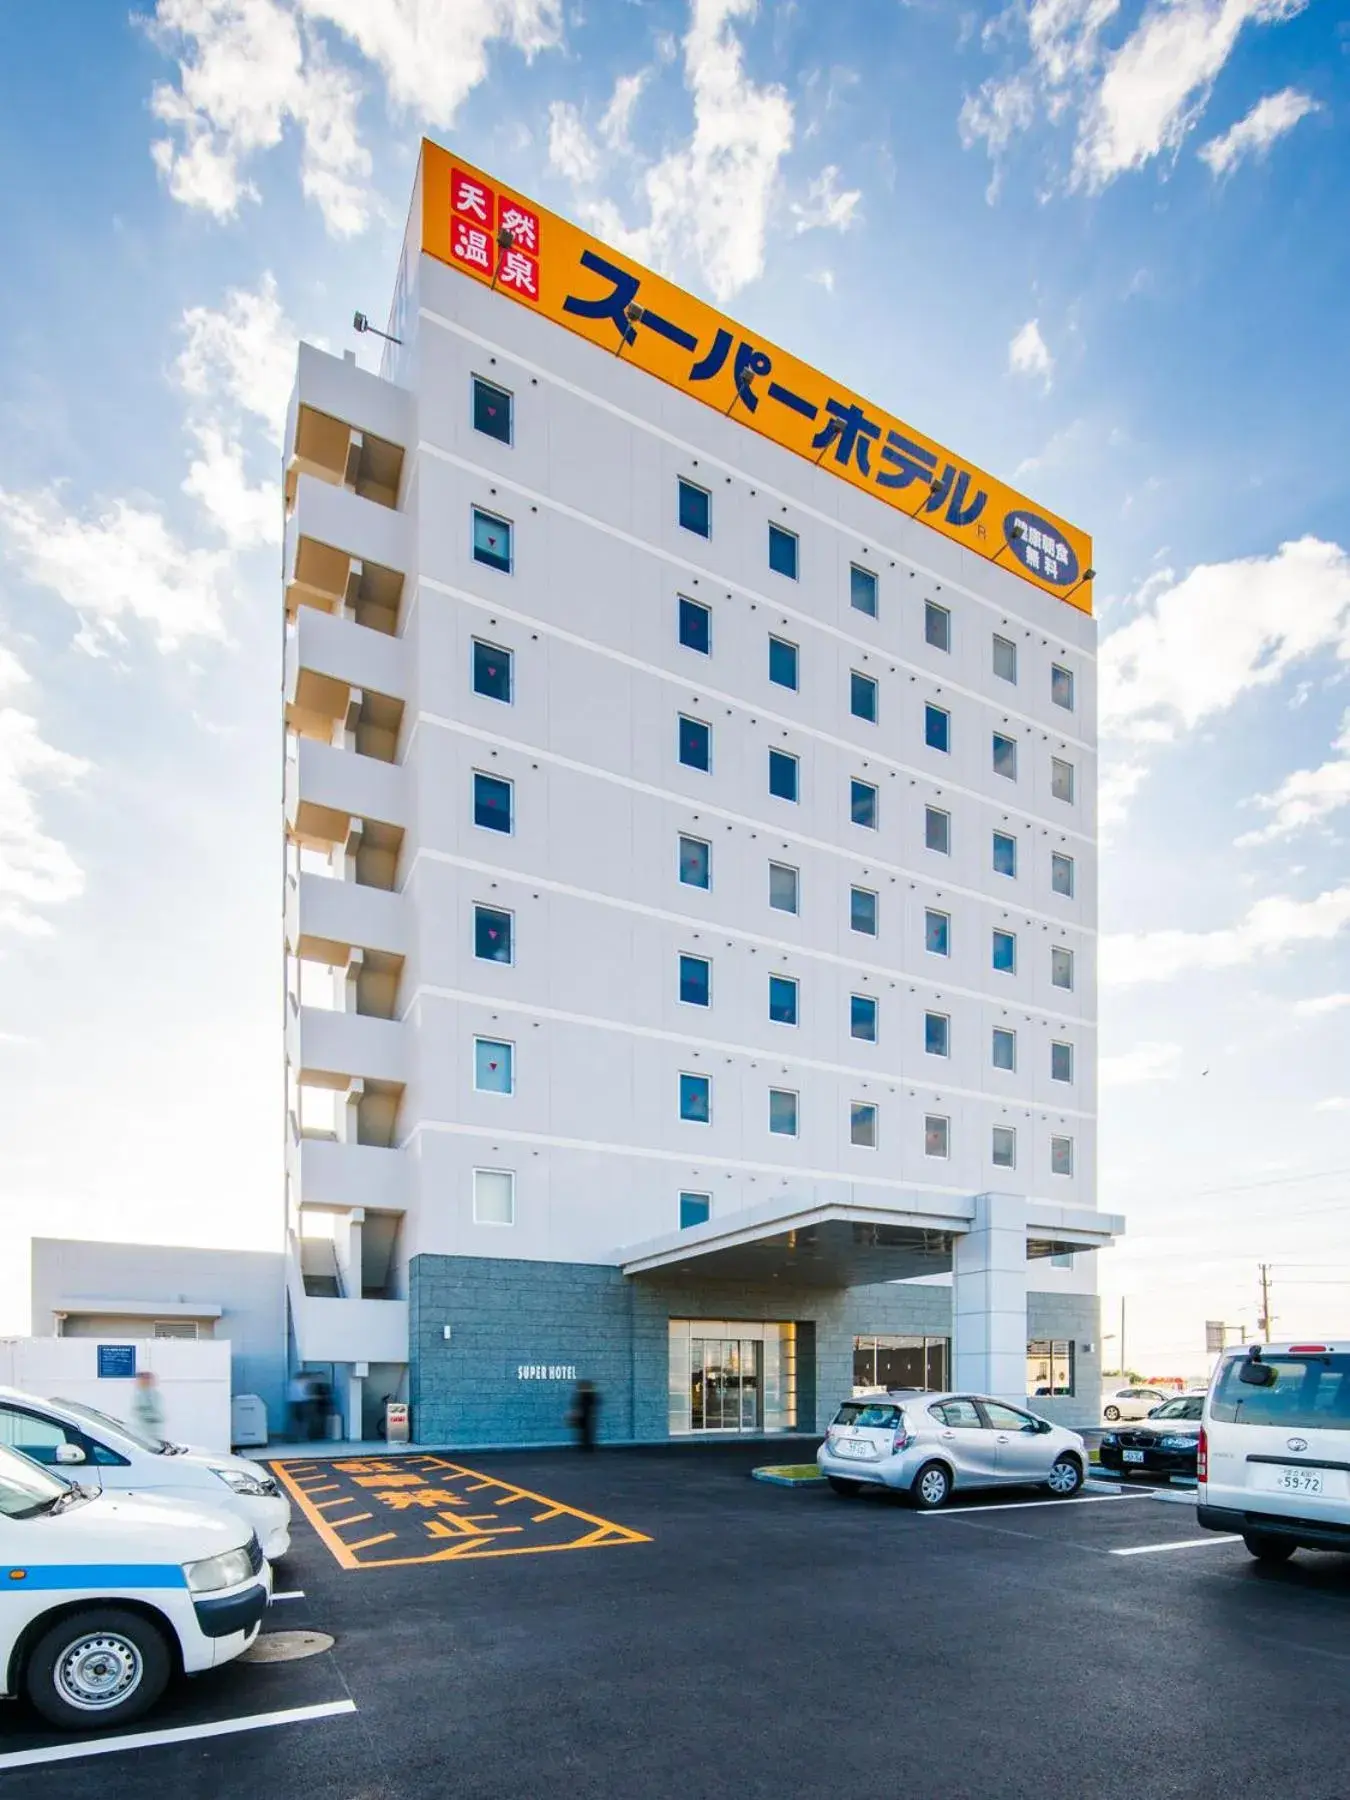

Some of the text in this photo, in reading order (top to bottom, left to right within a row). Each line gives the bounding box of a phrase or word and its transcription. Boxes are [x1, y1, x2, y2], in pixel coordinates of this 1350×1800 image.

[457, 182, 537, 249] 天然
[454, 224, 537, 294] 温泉
[562, 249, 988, 527] スーパーホテル
[518, 1365, 577, 1380] SUPER HOTEL
[1284, 1476, 1320, 1492] 59-72
